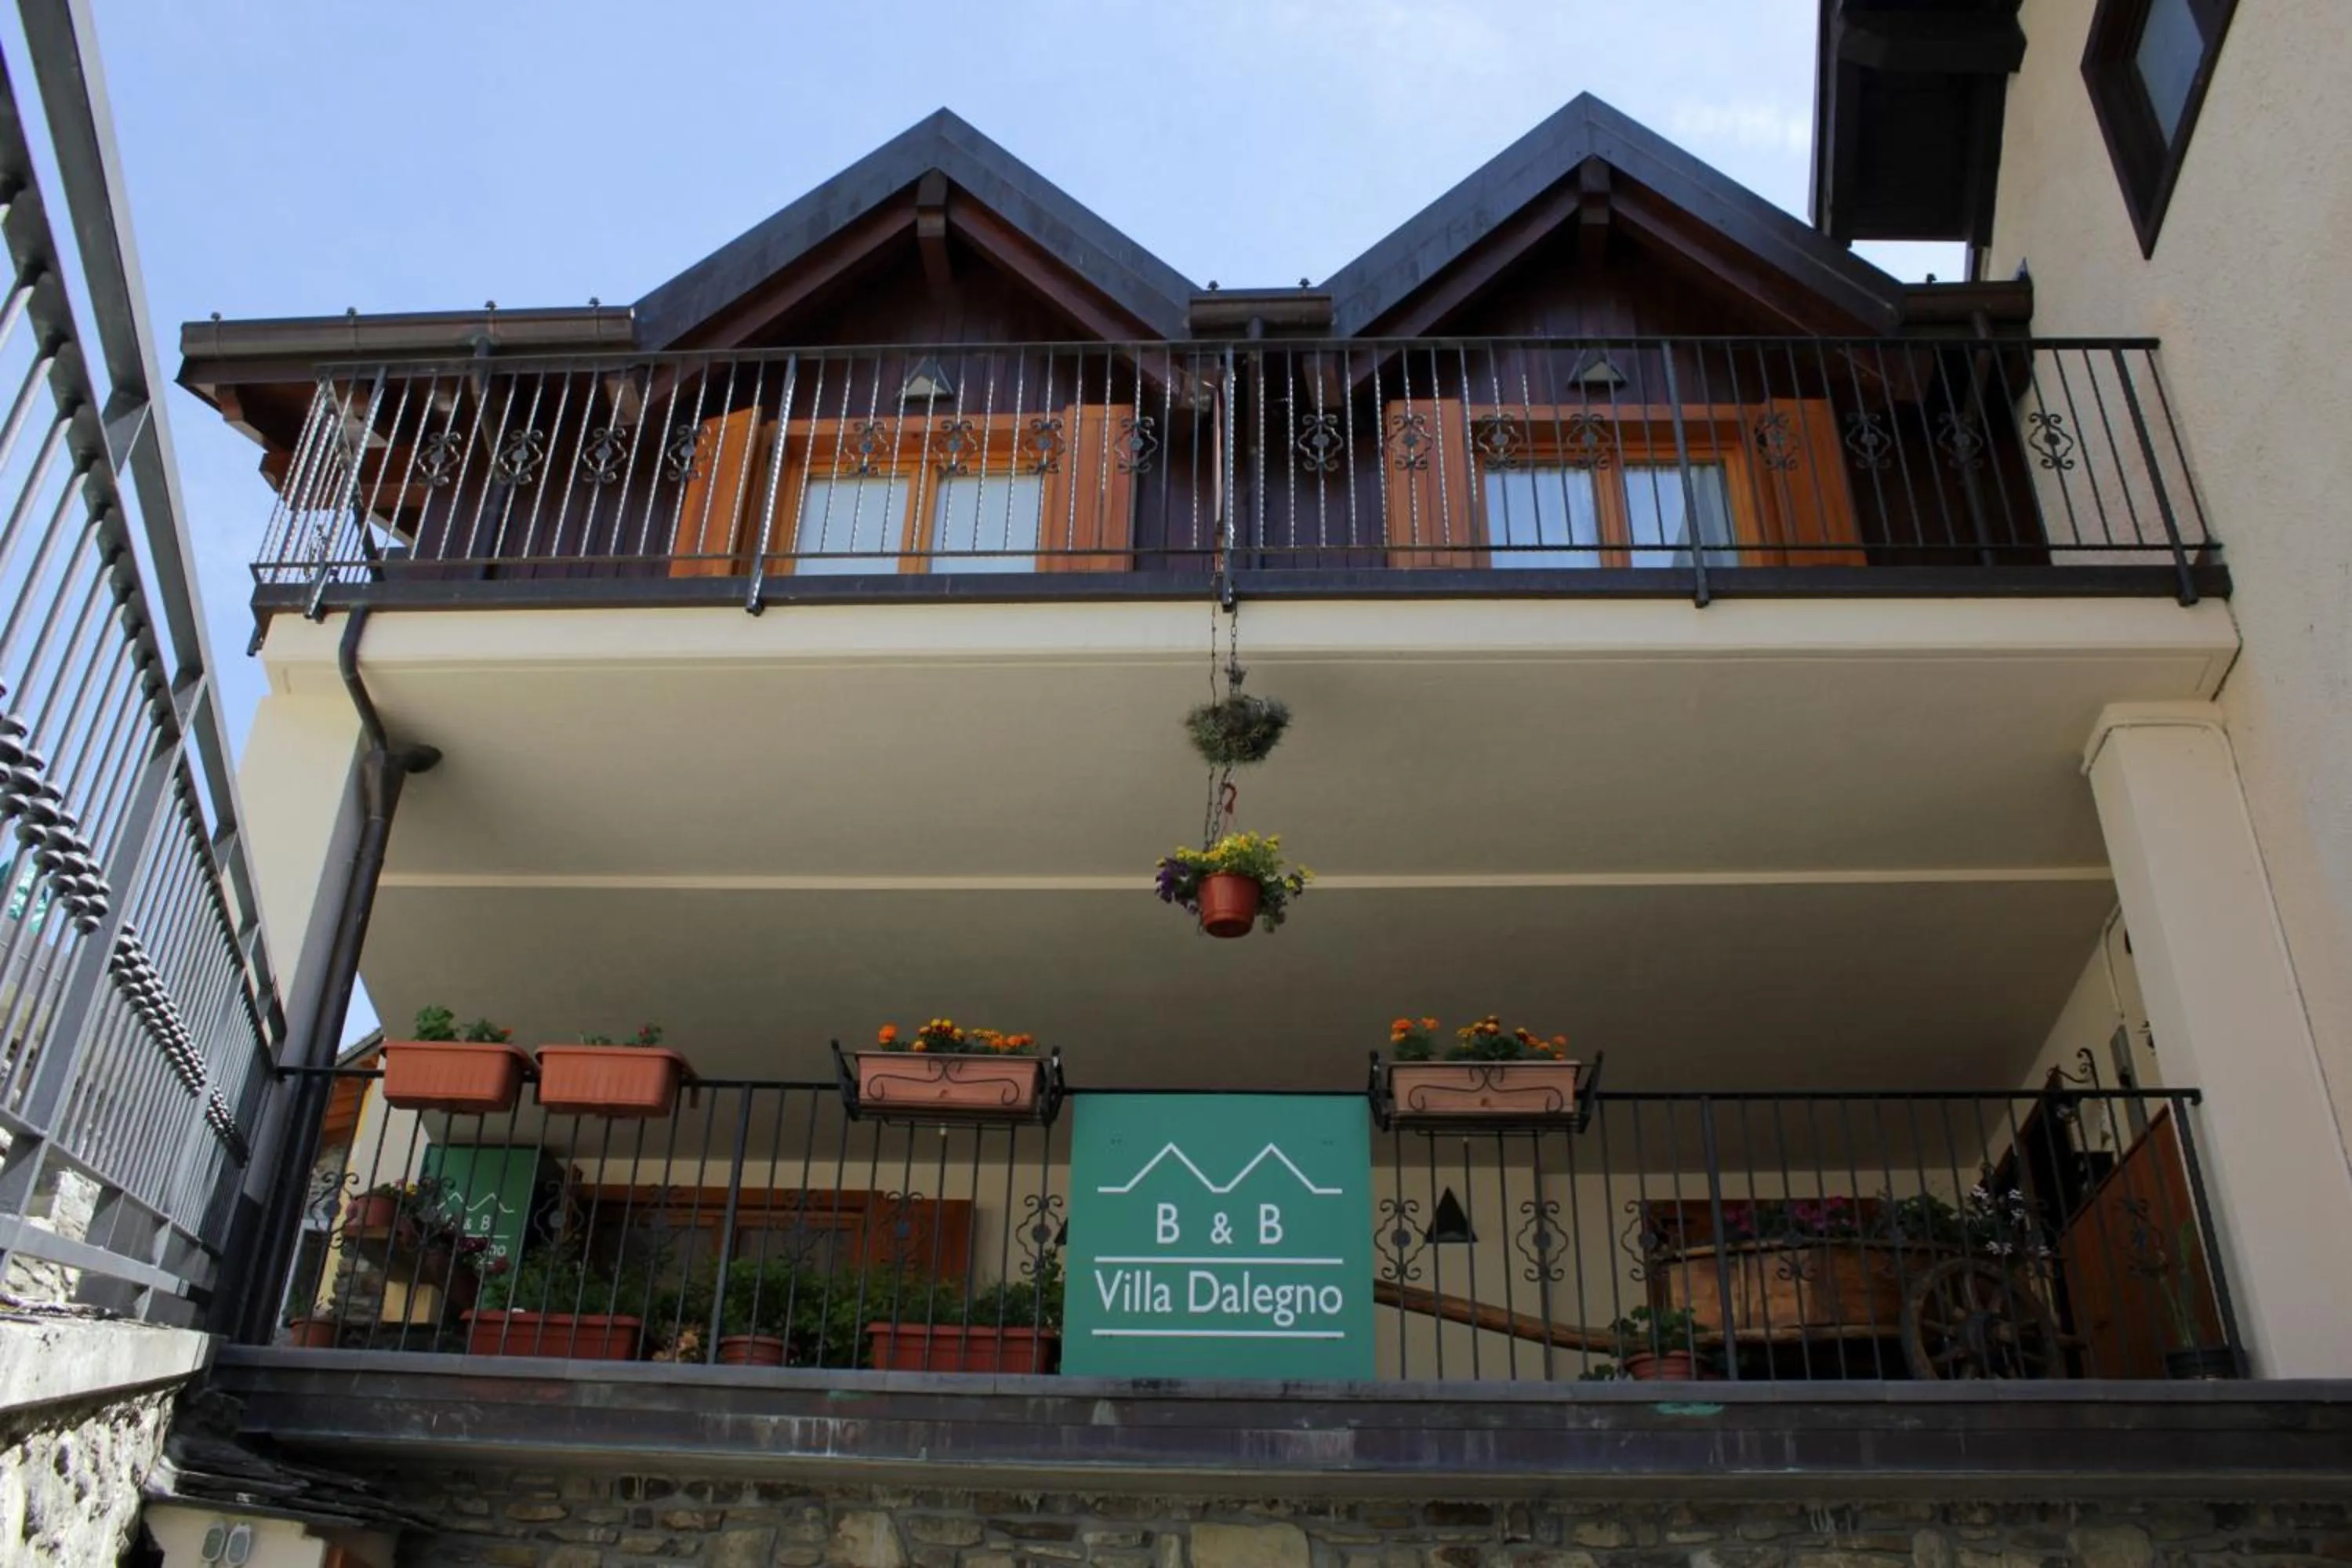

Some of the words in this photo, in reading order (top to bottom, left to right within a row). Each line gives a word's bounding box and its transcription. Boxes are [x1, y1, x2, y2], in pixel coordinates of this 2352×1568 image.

[1156, 1203, 1180, 1244] B
[1210, 1212, 1233, 1244] &
[1259, 1203, 1283, 1244] B
[1095, 1269, 1172, 1312] Villa
[1189, 1271, 1343, 1327] Dalegno
